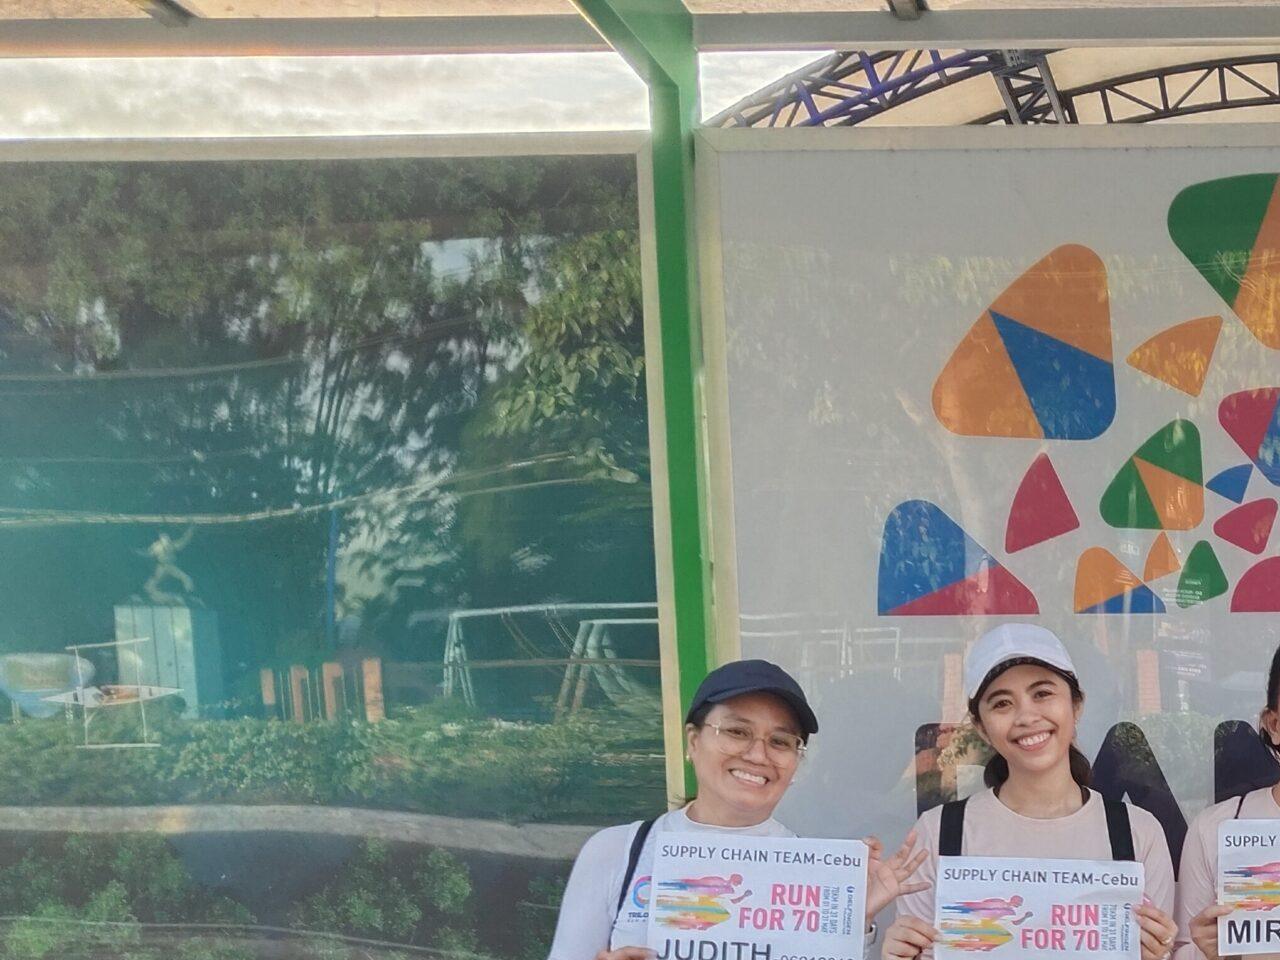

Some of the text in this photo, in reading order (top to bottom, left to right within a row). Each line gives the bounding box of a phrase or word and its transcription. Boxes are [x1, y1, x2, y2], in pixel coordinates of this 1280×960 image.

[1225, 834, 1277, 847] SUPPLY
[661, 845, 861, 867] SUPPLY CHAIN TEAM-Cebu
[944, 868, 1139, 886] SUPPLY CHAIN TEAM-Cebu
[771, 884, 821, 907] RUN
[738, 907, 785, 931] FOR
[792, 910, 820, 932] 70
[1051, 904, 1099, 926] RUN
[1021, 928, 1066, 951] FOR
[1072, 929, 1100, 951] 70
